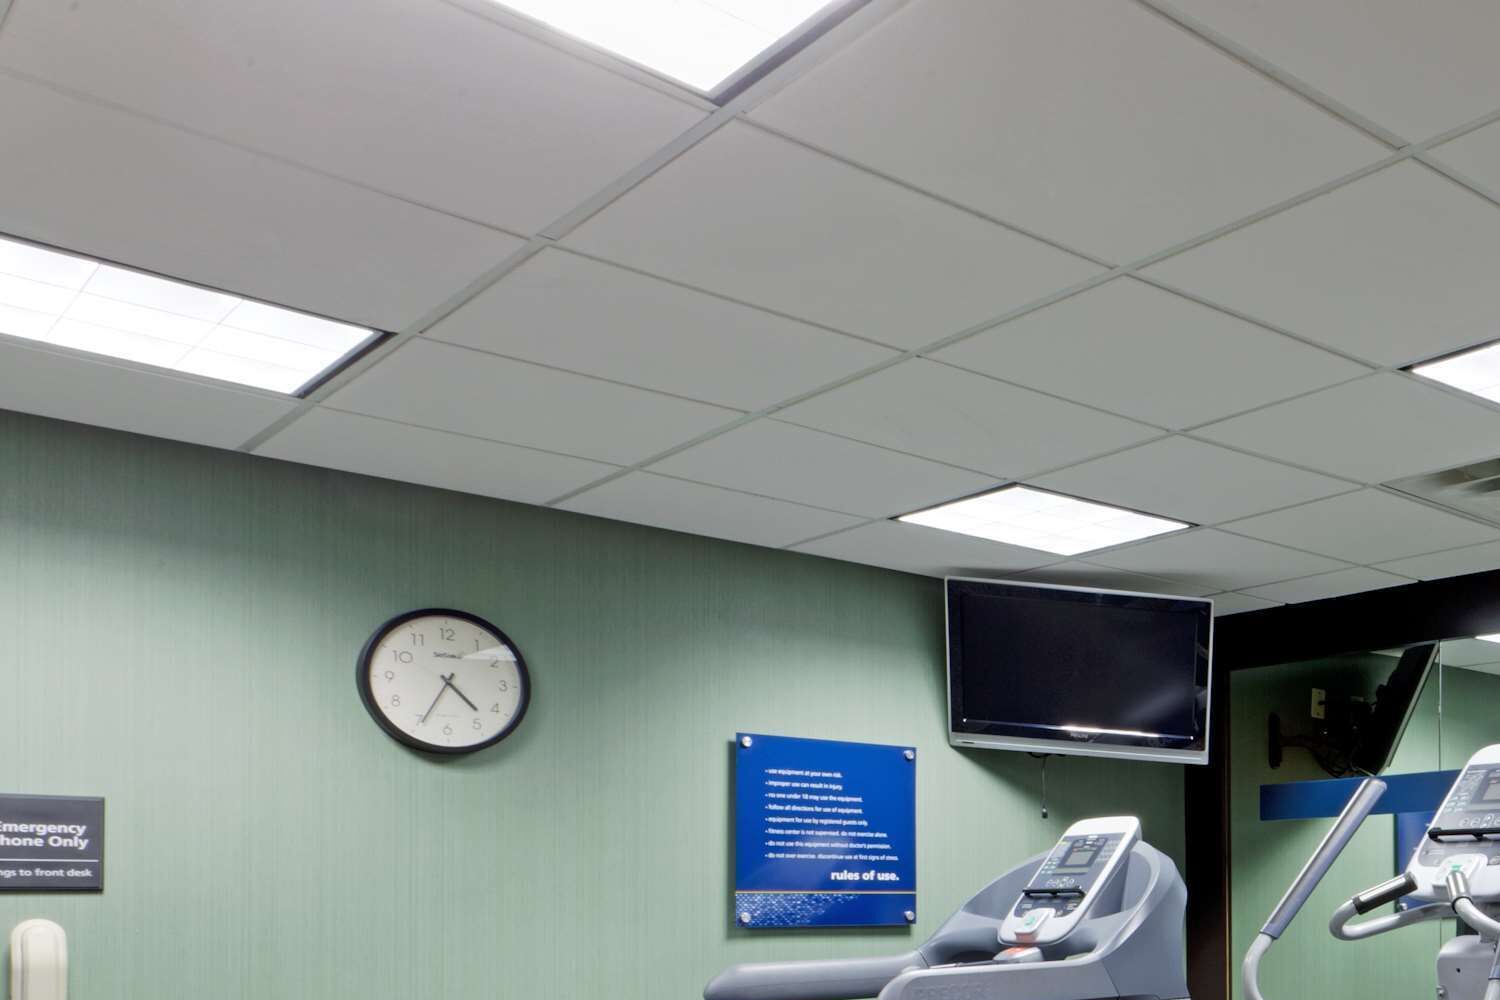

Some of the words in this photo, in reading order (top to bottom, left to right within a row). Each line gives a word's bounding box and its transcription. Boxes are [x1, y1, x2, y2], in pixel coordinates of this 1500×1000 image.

[411, 633, 424, 646] 11
[440, 628, 456, 641] 12
[392, 650, 413, 664] 10
[385, 671, 395, 682] 9
[499, 680, 508, 692] 3
[391, 694, 400, 707] 8
[490, 703, 500, 714] 4
[442, 723, 453, 736] 6
[472, 718, 482, 730] 5
[0, 820, 87, 836] mergency
[48, 836, 88, 850] Only
[19, 868, 32, 877] to
[34, 868, 64, 877] front
[66, 869, 92, 877] desk
[831, 869, 860, 881] rules
[862, 869, 876, 881] of
[877, 871, 899, 881] use.
